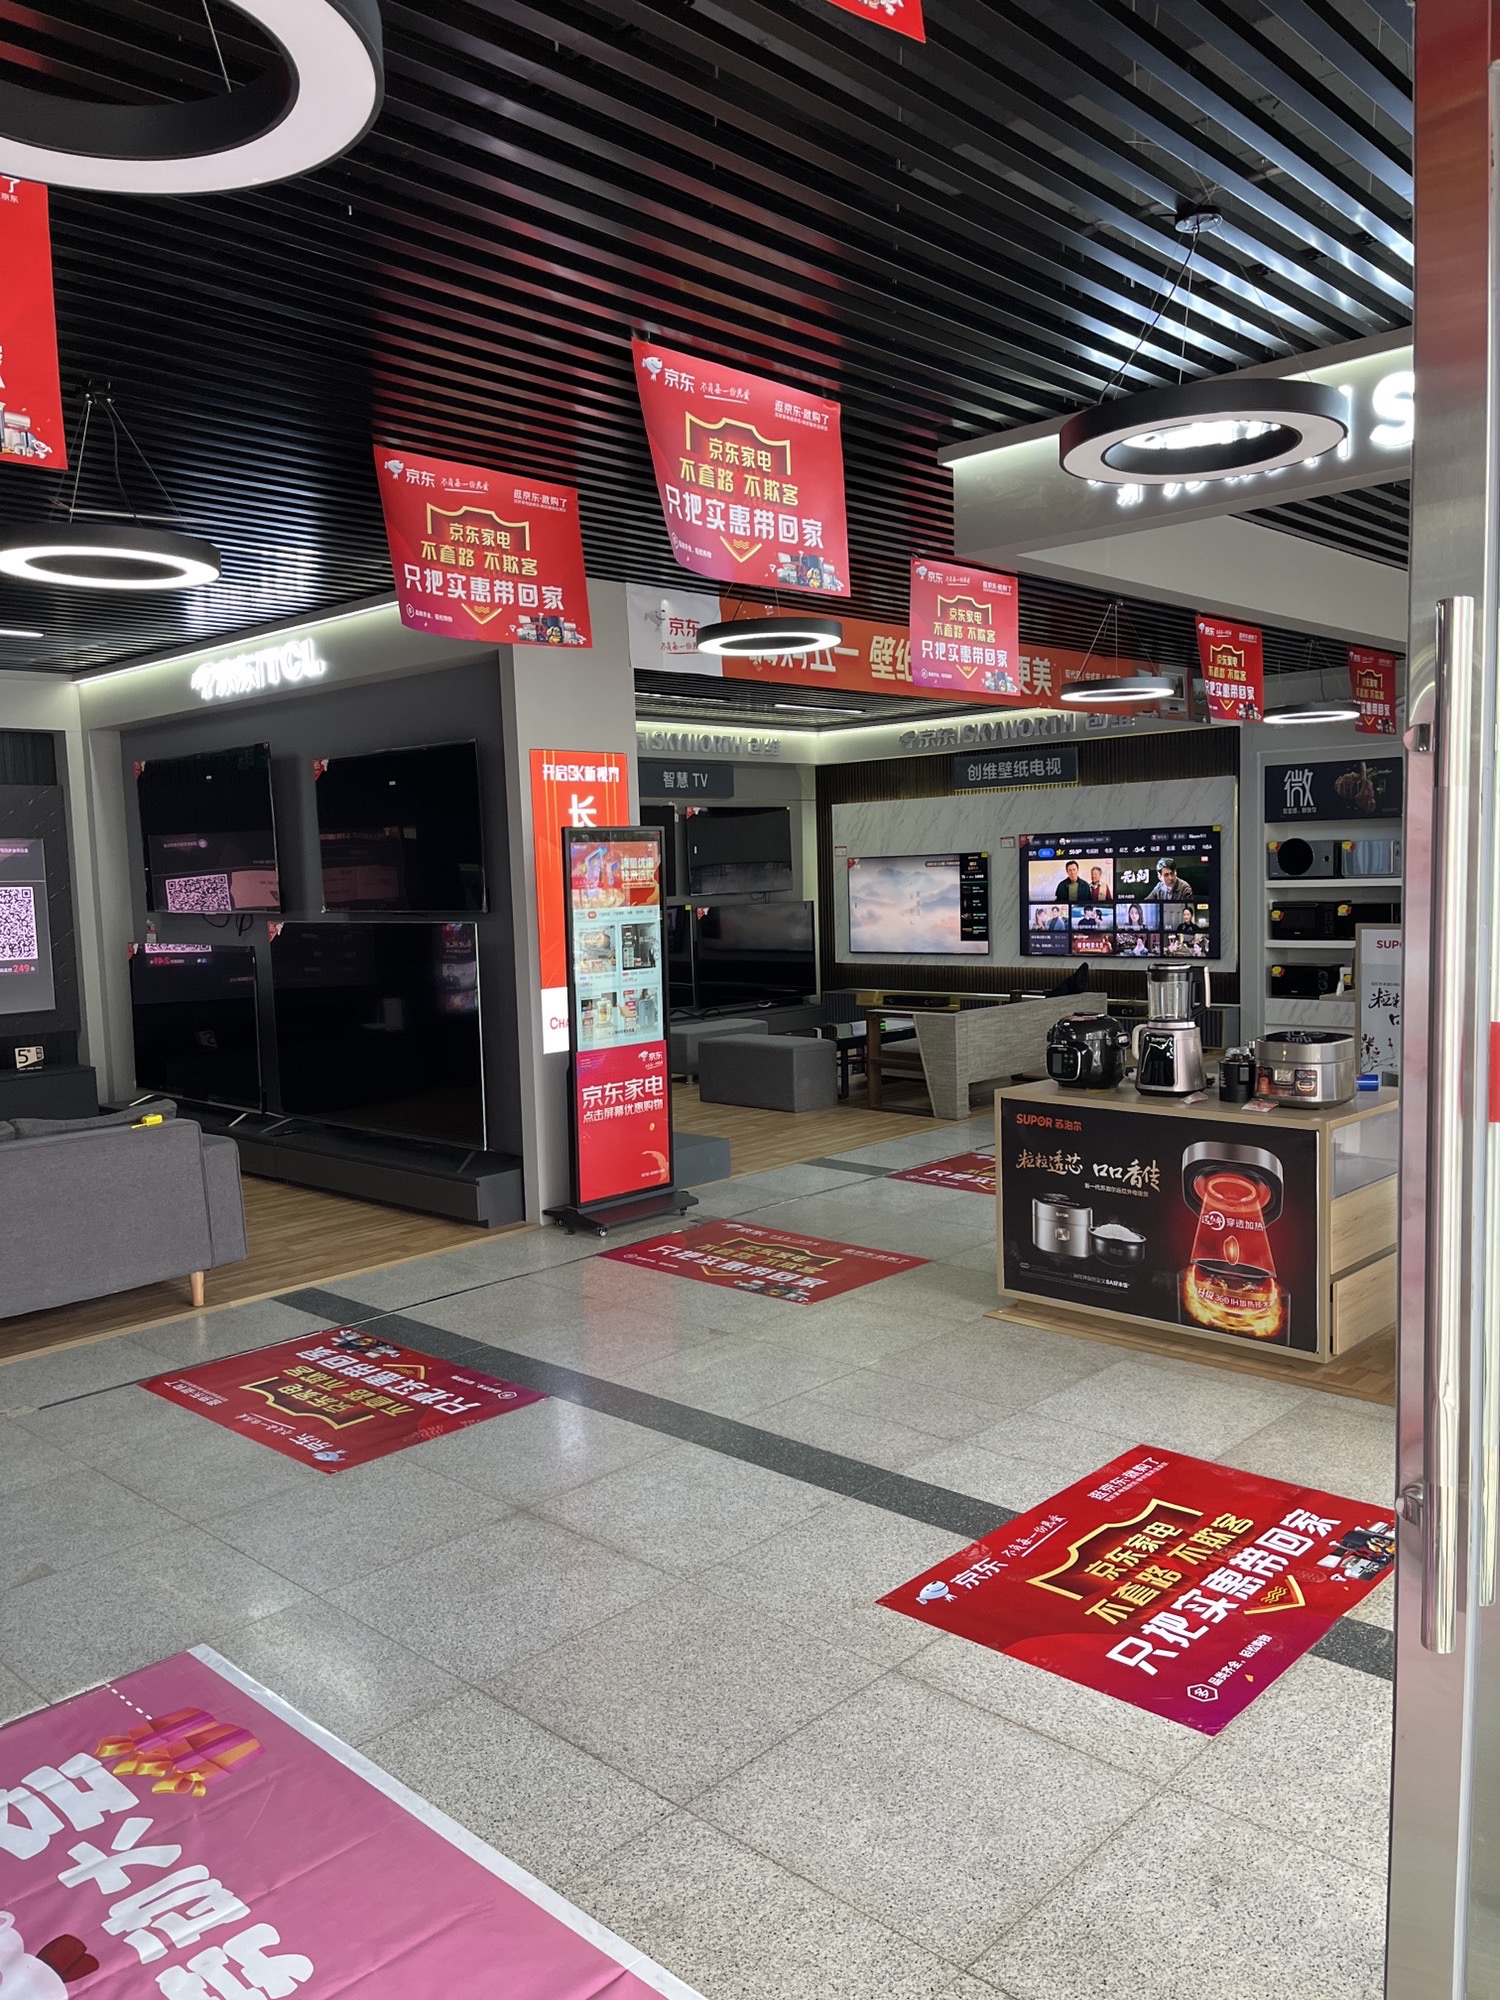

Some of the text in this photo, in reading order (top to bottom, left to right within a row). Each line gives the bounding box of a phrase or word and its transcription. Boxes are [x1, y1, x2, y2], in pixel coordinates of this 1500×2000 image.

[664, 368, 695, 394] 京东
[708, 437, 772, 472] 京东家电
[405, 468, 436, 488] 京东
[679, 456, 799, 507] 不套路 不欺客
[665, 483, 824, 549] 只把实惠带回家
[449, 522, 511, 550] 京东家电
[420, 540, 539, 577] 不套路 不欺客
[404, 563, 565, 611] 只把实惠带回家
[949, 608, 982, 625] 京东家电
[921, 639, 1009, 668] 只把实惠带回家
[652, 732, 744, 754] SKYWORTH
[963, 713, 1076, 744] SKYWORTH
[662, 770, 709, 788] 智慧 TV
[967, 757, 1062, 782] 创维壁纸电视
[1283, 769, 1315, 808] 微
[1376, 940, 1402, 949] SUP
[12, 964, 30, 973] 249
[582, 1075, 664, 1109] 京东家电
[583, 1098, 664, 1124] 点击屏幕优惠购物
[1016, 1113, 1082, 1132] SUPOR 苏泊尔
[648, 1244, 829, 1289] 只把实惠带回家
[295, 1345, 482, 1415] 只把实惠带回家
[1083, 1520, 1183, 1581] 京东家电
[950, 1556, 1008, 1590] 京东
[1084, 1512, 1255, 1625] 不套路 不欺客
[1105, 1507, 1341, 1676] 只把实惠带回家
